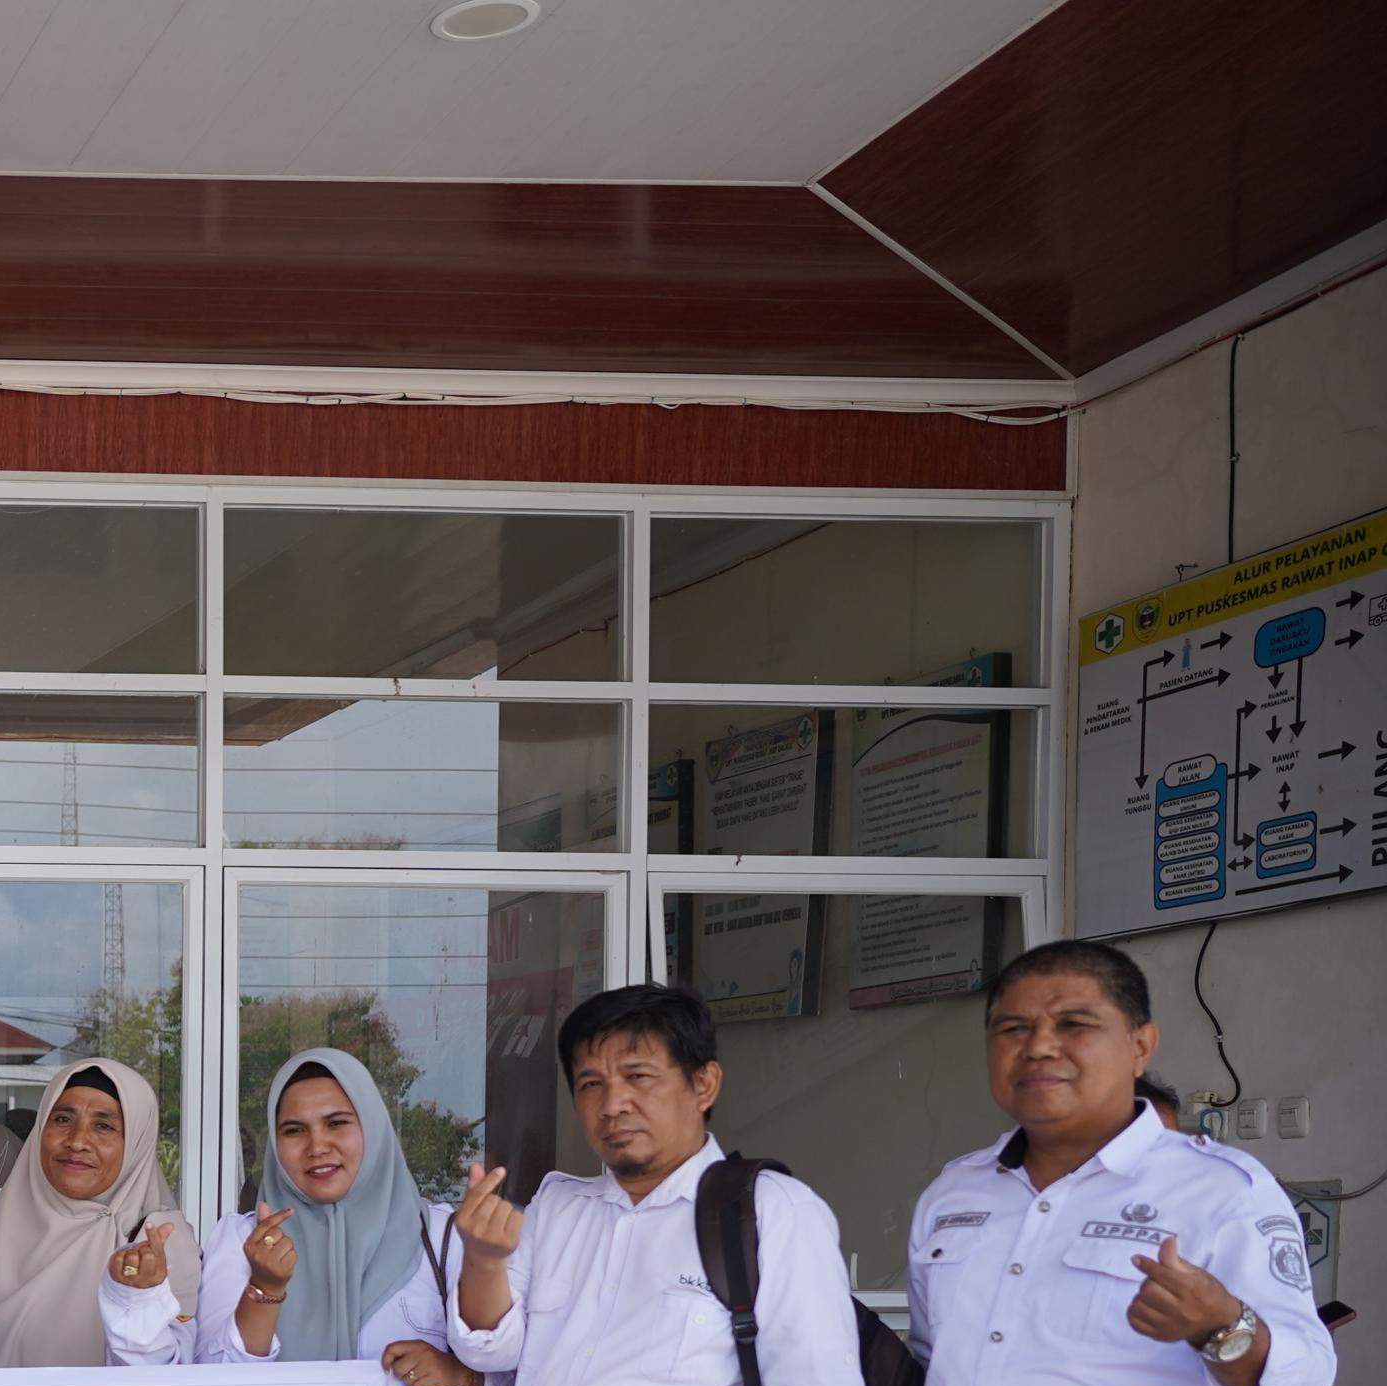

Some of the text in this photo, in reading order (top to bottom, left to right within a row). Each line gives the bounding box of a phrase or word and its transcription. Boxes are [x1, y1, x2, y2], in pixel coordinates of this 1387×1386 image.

[1233, 527, 1367, 585] ALUR PELAYANAN
[1167, 547, 1377, 628] UPT PUSKESMAS RAWAT INAP
[1184, 667, 1214, 683] DATANG
[1272, 750, 1300, 764] RAWAT
[1177, 761, 1203, 773] RAWAT
[1276, 763, 1295, 774] INAP
[1178, 772, 1201, 785] JALAN
[1093, 1224, 1162, 1243] DPPPA
